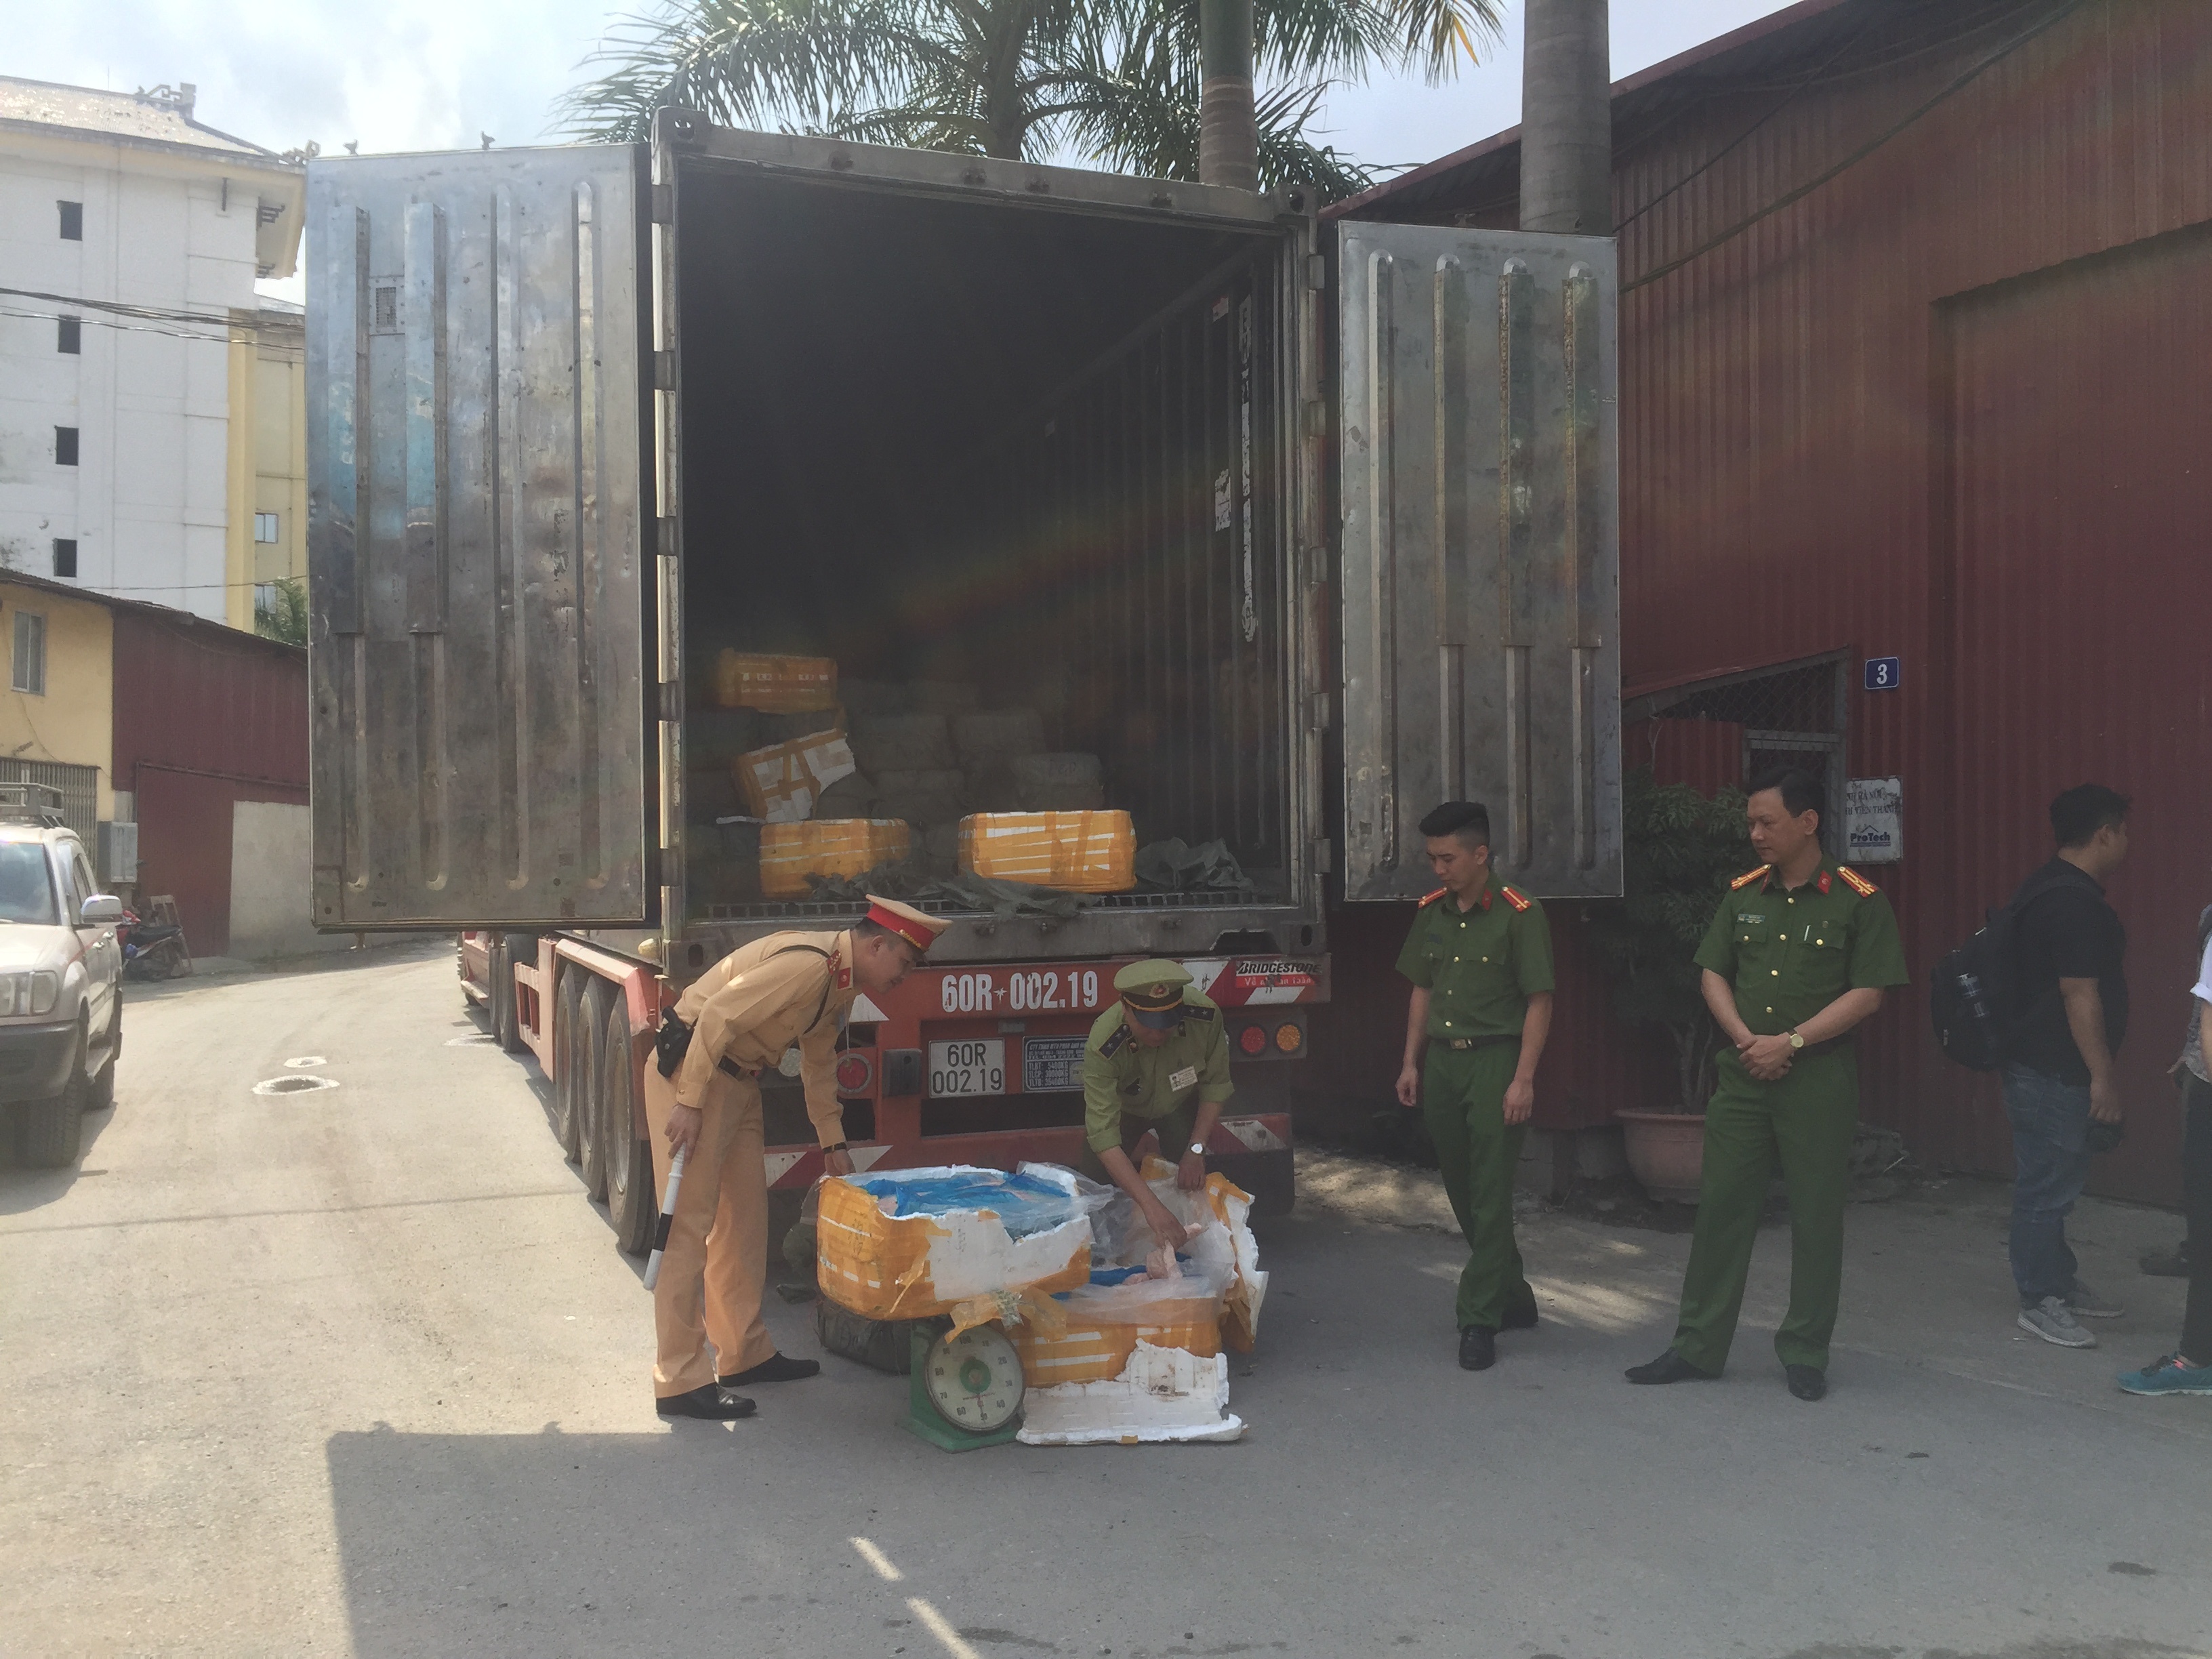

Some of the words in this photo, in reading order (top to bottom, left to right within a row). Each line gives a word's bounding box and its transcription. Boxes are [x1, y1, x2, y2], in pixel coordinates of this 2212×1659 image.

[1877, 663, 1887, 684] 3
[1850, 832, 1890, 842] ProTech
[1237, 962, 1321, 975] BRIDGESTONE
[941, 974, 993, 1012] 60R
[1010, 970, 1098, 1010] 002.19
[947, 1043, 987, 1067] 60R
[933, 1067, 1002, 1094] 002.19
[959, 1335, 971, 1345] 100
[998, 1356, 1008, 1366] 20
[996, 1399, 1005, 1408] 40
[956, 1407, 966, 1416] 60
